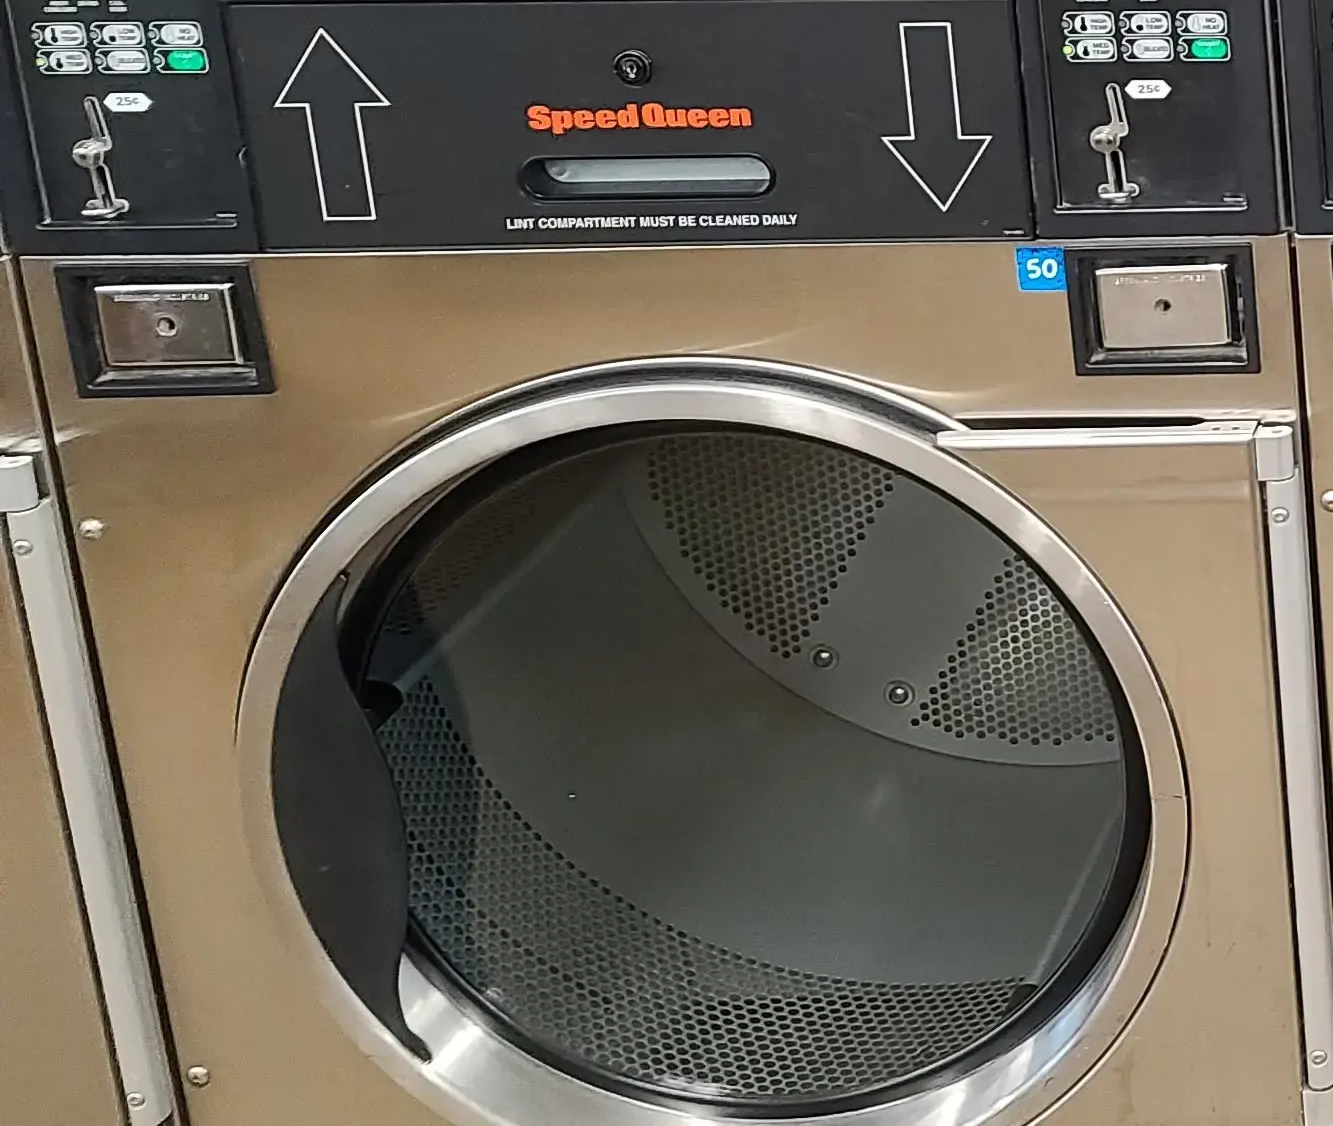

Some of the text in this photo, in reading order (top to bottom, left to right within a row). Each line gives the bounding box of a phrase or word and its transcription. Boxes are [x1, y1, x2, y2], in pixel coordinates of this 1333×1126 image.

[527, 102, 752, 136] Speed Queen
[505, 213, 798, 230] LINT COMPARTMENT MUST BE CLEANED DAILY
[1026, 258, 1058, 279] 50
